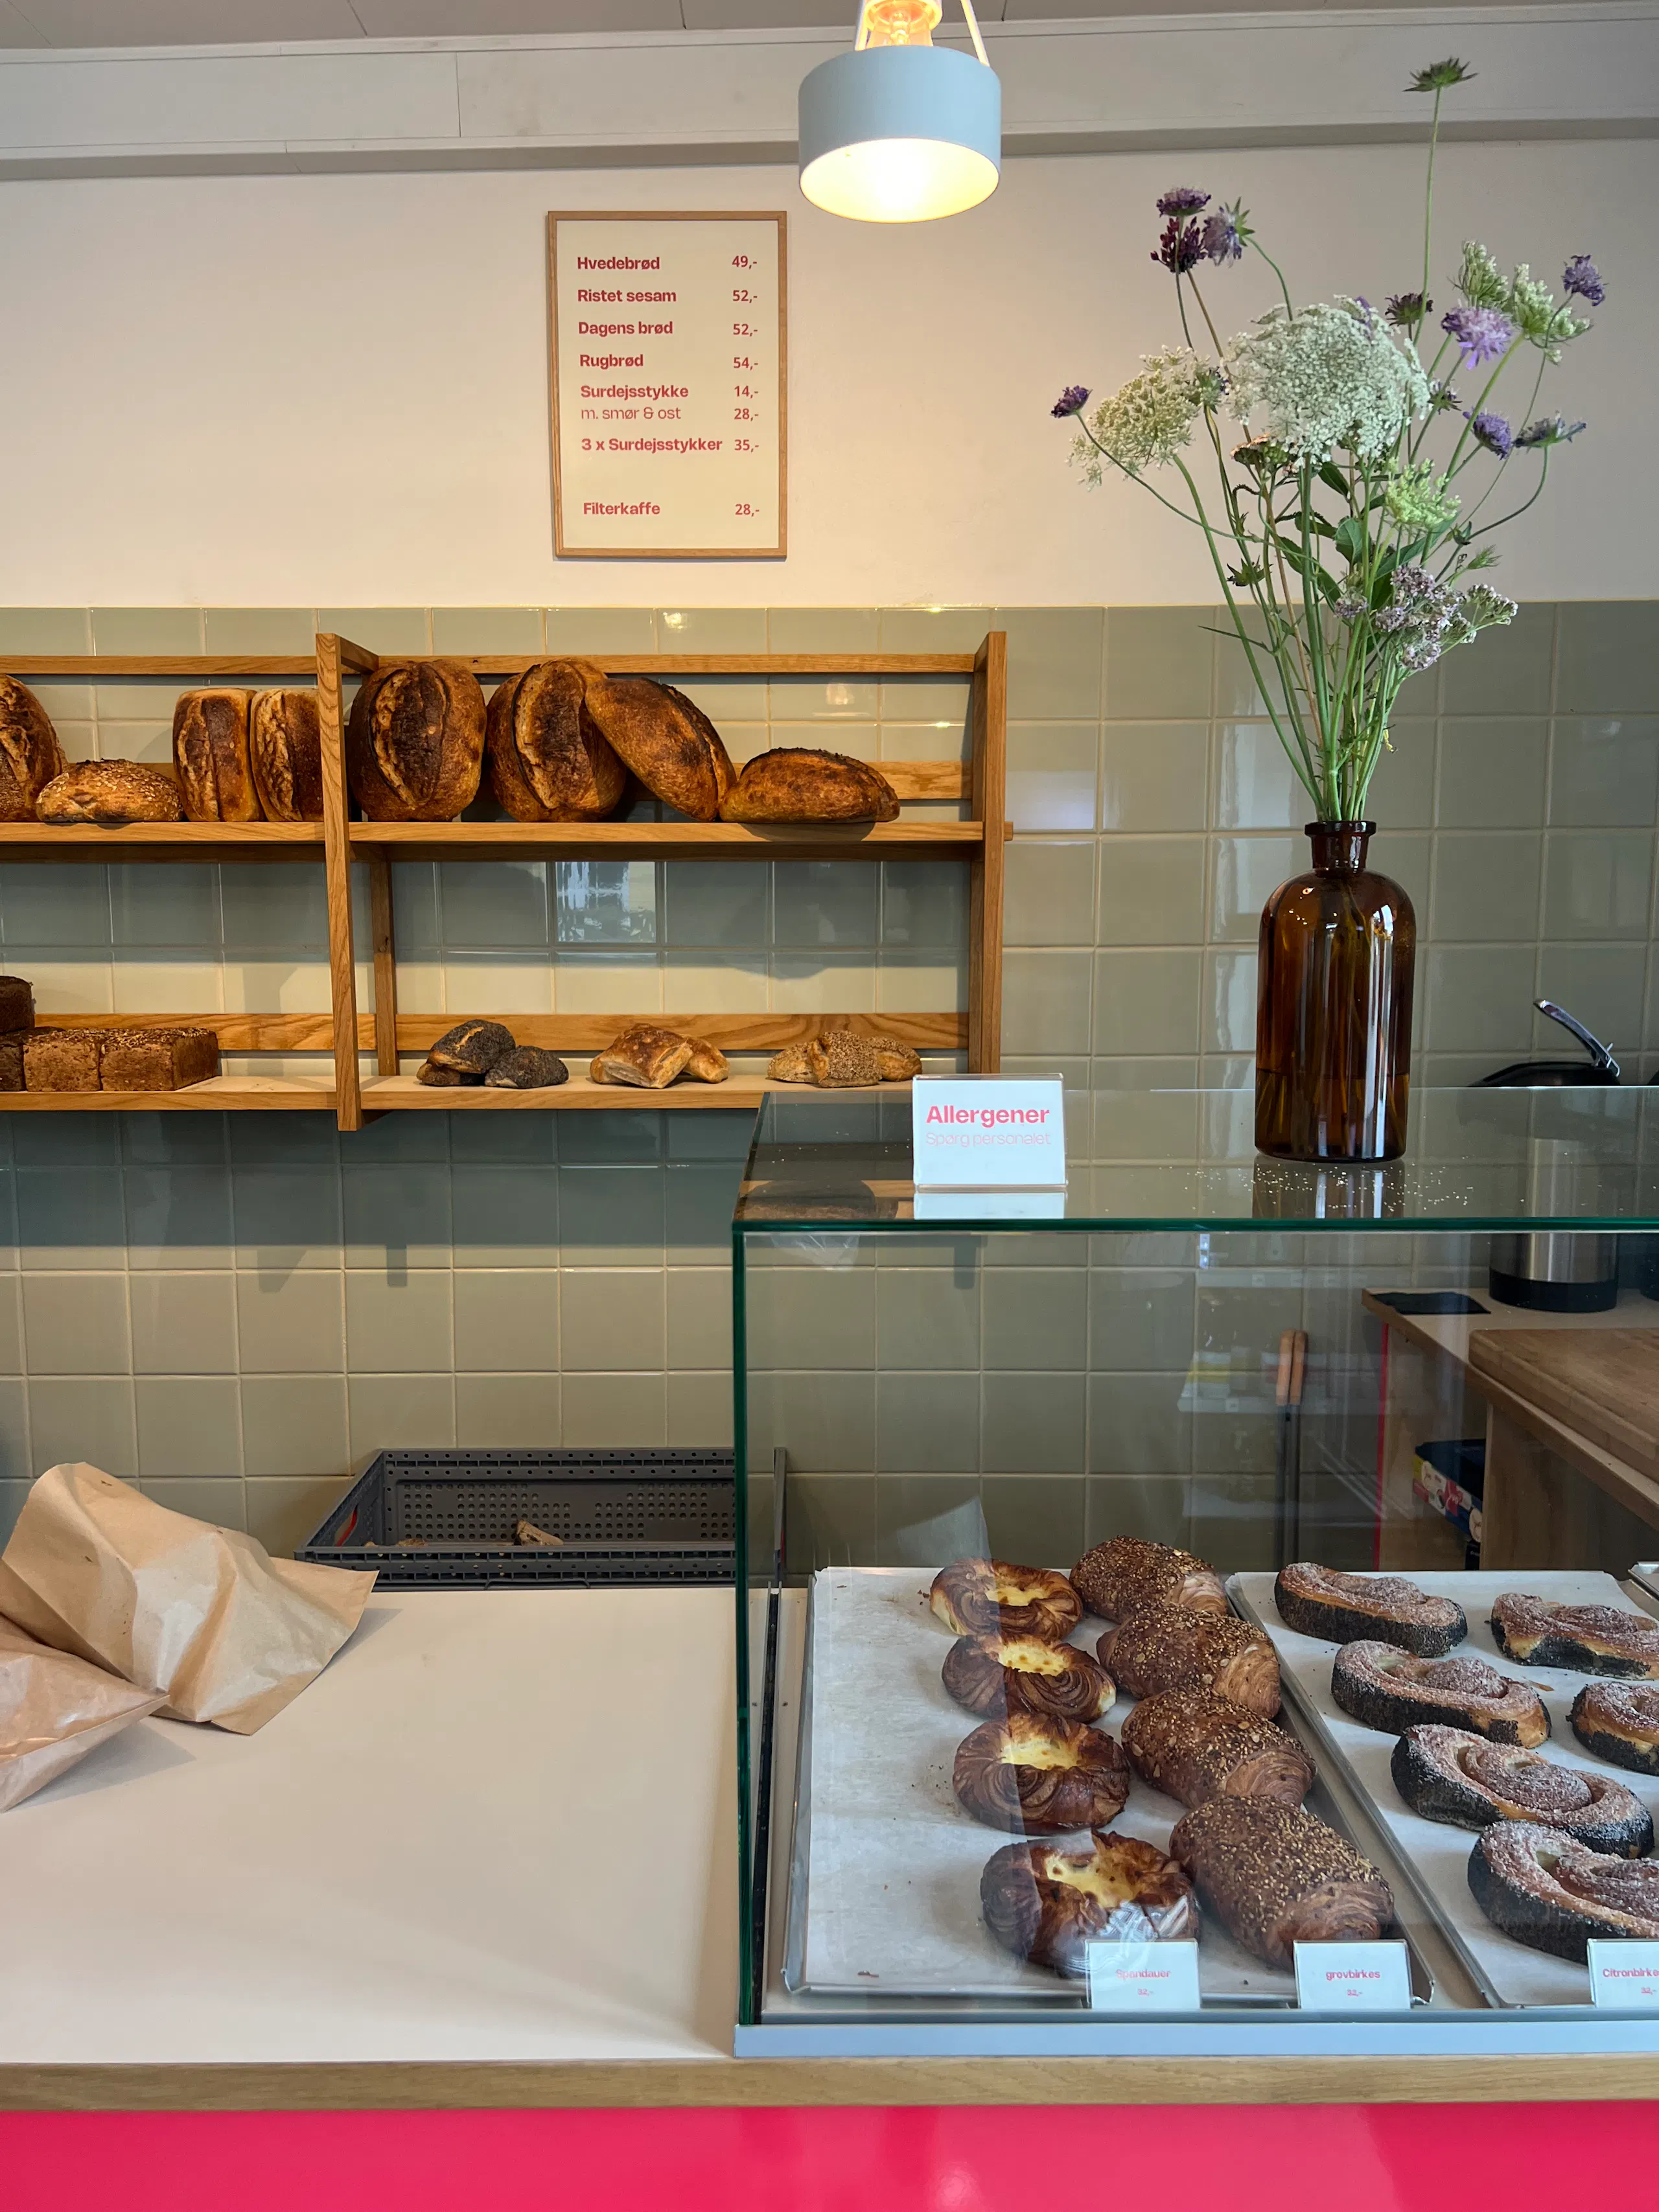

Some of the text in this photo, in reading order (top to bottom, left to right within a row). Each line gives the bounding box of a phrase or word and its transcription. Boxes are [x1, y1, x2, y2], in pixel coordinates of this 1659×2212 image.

[577, 255, 758, 270] Hvedebrød 49,-
[577, 289, 758, 303] Ristet sesam 52,-
[578, 321, 758, 338] Dagens brød 52,-
[579, 354, 759, 370] Rugbrød 54,-
[580, 385, 759, 401] Surdejsstykke 14,-
[581, 407, 759, 421] m. smør & ost 28,-
[581, 438, 760, 454] 3 x Surdejsstykker 35,-
[583, 502, 760, 517] Filterkaffe 28,-
[925, 1105, 1050, 1128] Allergener
[925, 1132, 1051, 1147] Spørg personalet
[1116, 1968, 1172, 1980] Spandauer
[1325, 1969, 1381, 1981] grovbirkes
[1603, 1968, 1659, 1978] Citronbirke
